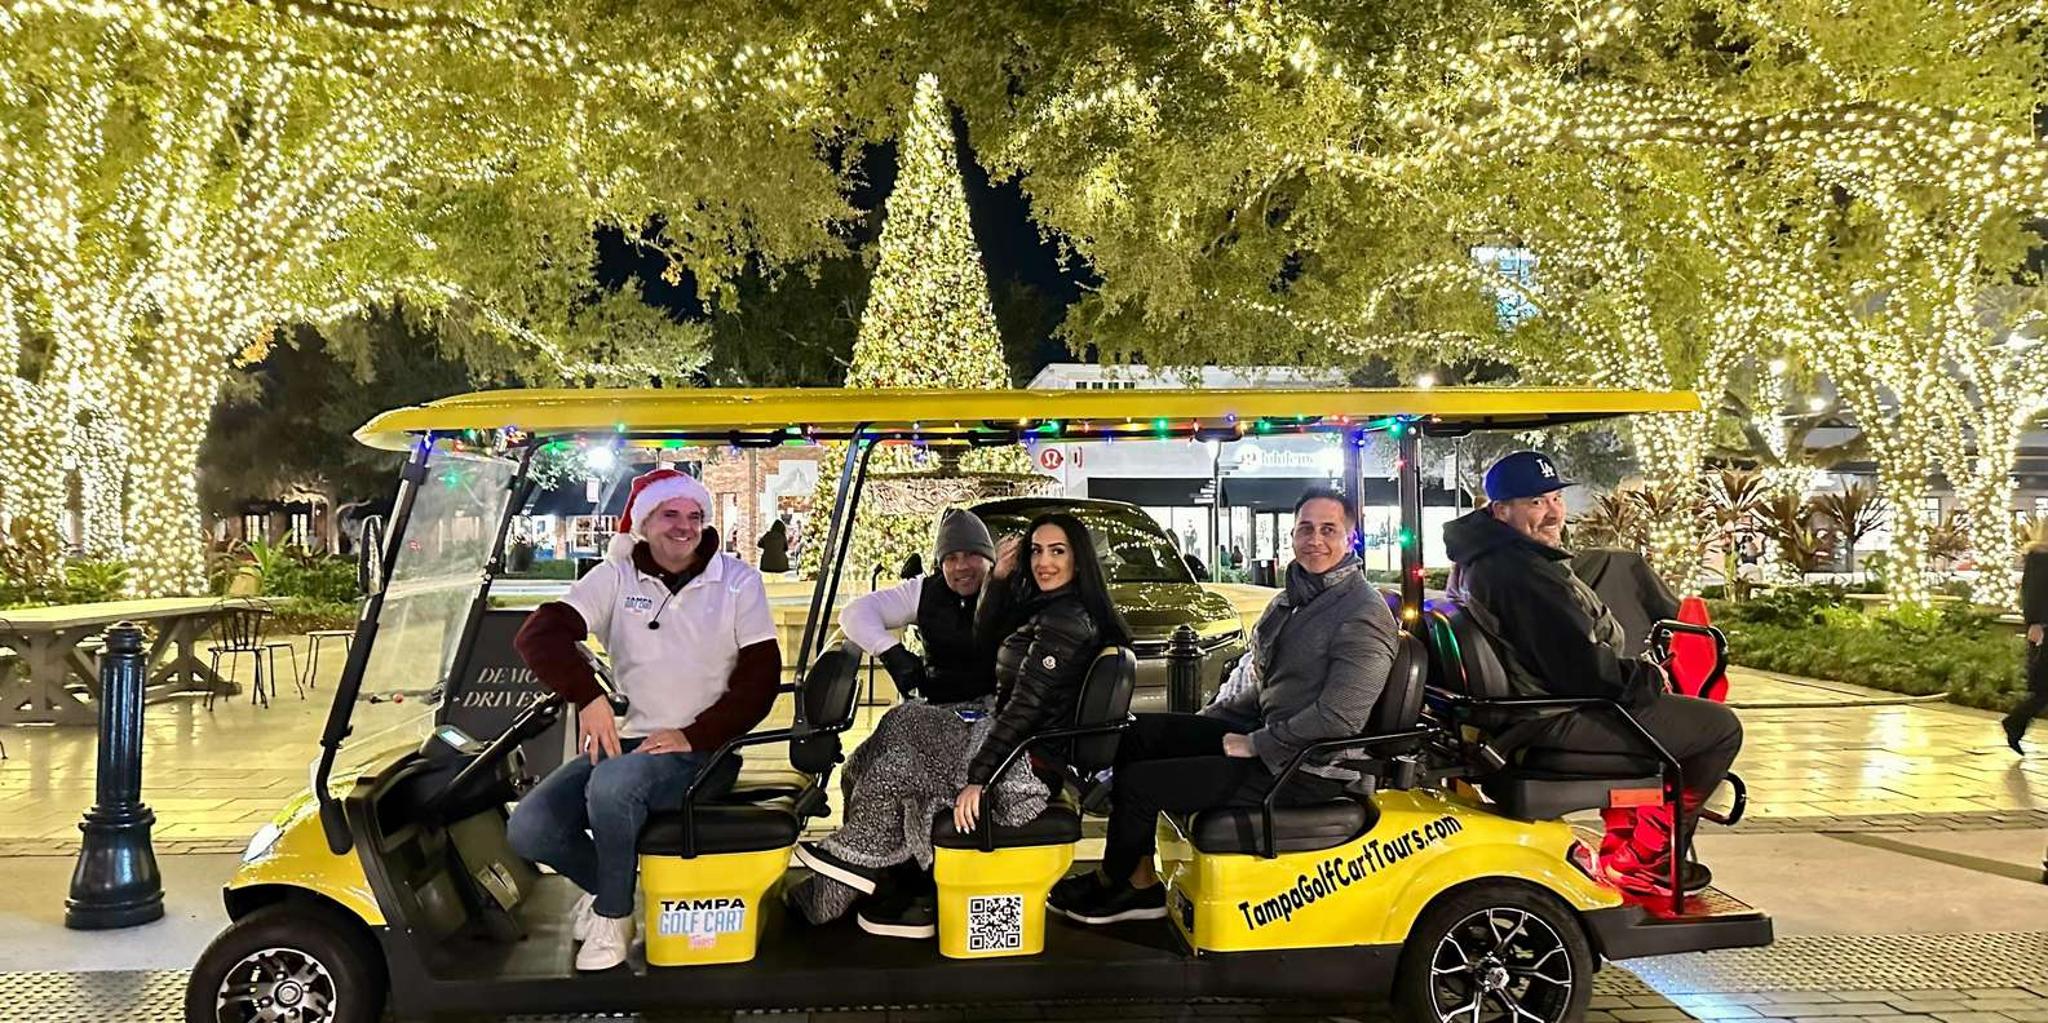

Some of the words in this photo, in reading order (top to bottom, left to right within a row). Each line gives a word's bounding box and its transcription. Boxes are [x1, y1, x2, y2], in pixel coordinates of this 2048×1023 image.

[1536, 459, 1555, 477] LA
[1238, 814, 1463, 931] TampaGolfCartTours.com
[660, 898, 745, 912] TAMPA
[660, 912, 700, 934] GOLF
[703, 910, 745, 933] CART
